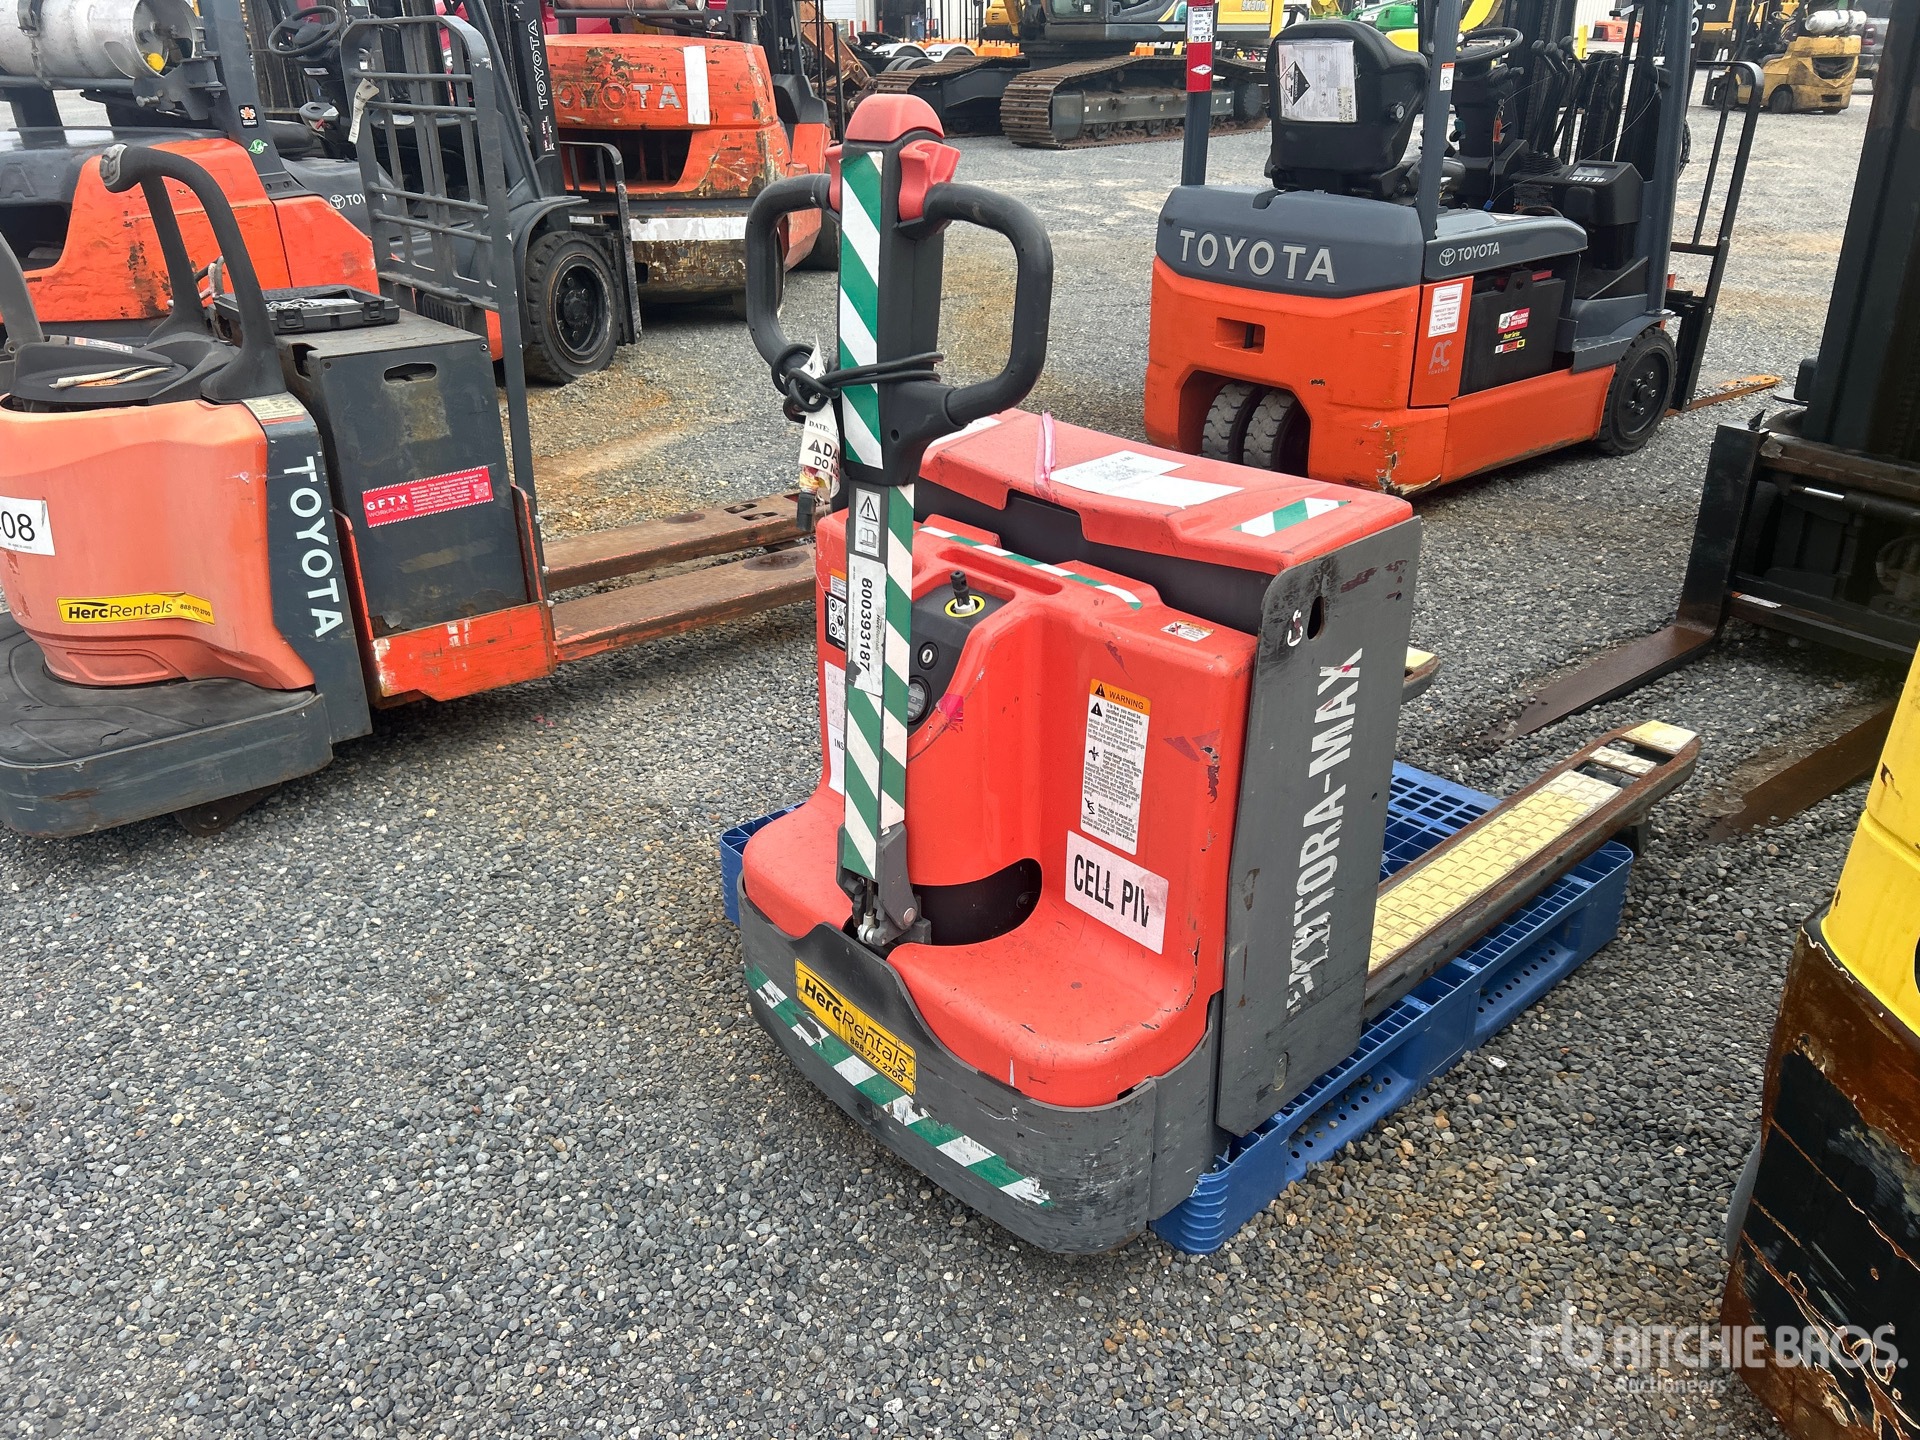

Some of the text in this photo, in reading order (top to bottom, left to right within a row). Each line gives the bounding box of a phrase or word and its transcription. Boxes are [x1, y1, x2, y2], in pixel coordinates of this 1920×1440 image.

[528, 19, 549, 110] TOYOTA
[552, 82, 682, 111] OYOTA
[1178, 229, 1336, 284] TOYOTA
[1457, 241, 1500, 261] TOYOTA
[809, 420, 830, 432] DATE:
[814, 456, 828, 470] DO
[368, 504, 409, 518] WORKPLACE
[284, 456, 344, 638] TOYOTA
[68, 600, 211, 619] HercRentals 888-777-2700
[860, 577, 872, 672] 800393187
[1109, 690, 1144, 710] WARNING
[1074, 854, 1114, 910] CELL
[804, 979, 908, 1073] HercRentals
[850, 1036, 904, 1082] 888-777-2700
